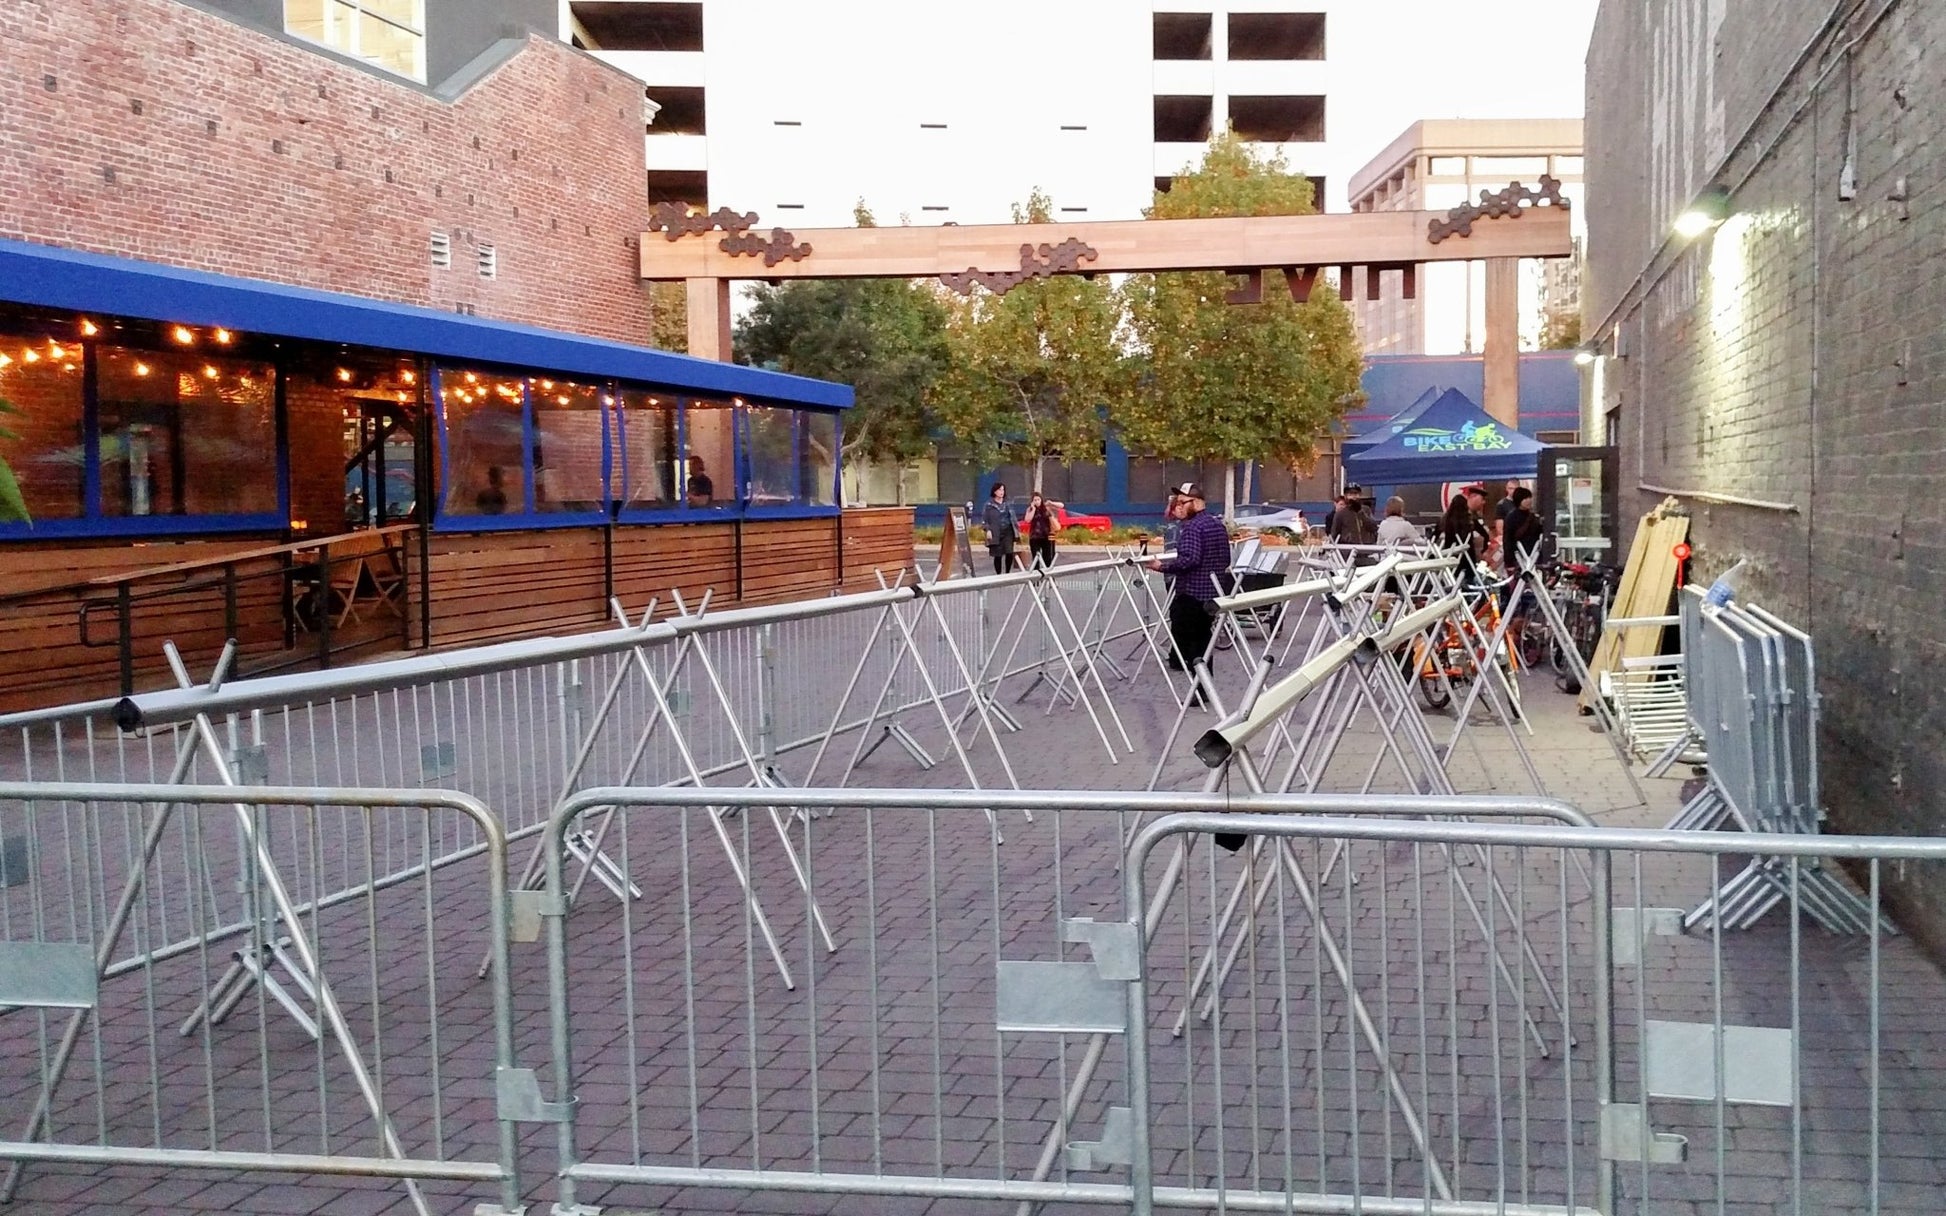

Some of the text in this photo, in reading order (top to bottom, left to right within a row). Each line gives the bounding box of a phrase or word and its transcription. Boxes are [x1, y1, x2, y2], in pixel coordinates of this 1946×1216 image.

[1403, 435, 1452, 447] BIKE
[1418, 440, 1513, 453] EAST BAY
